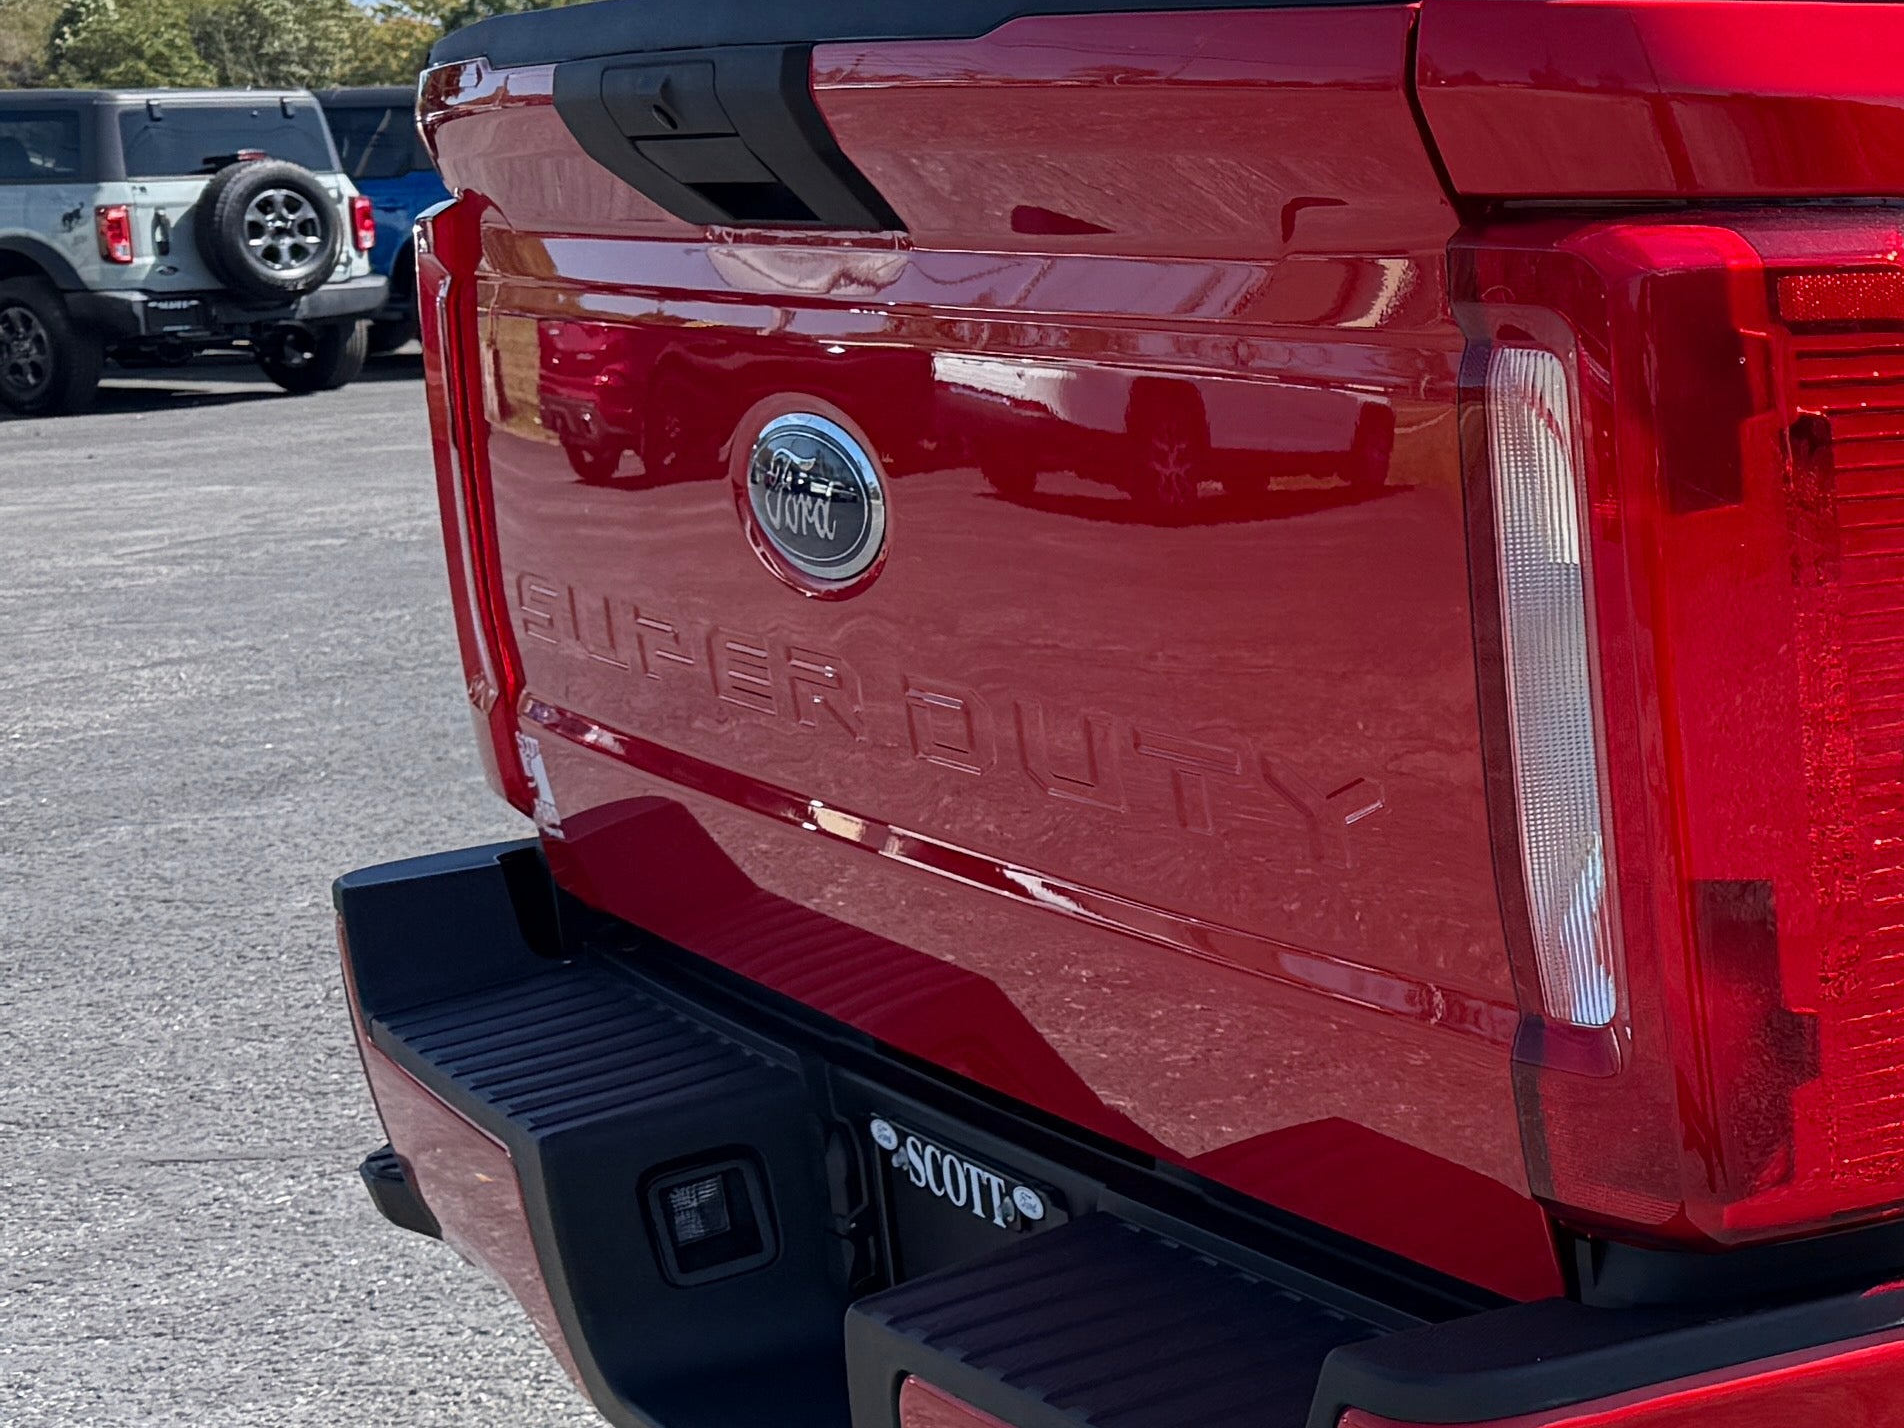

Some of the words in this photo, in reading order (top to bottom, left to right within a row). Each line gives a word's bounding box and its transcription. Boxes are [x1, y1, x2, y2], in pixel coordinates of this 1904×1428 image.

[764, 447, 837, 541] Ford
[515, 572, 868, 744] SUPER
[903, 672, 1387, 871] DUTY
[906, 1135, 1008, 1229] SCOTT
